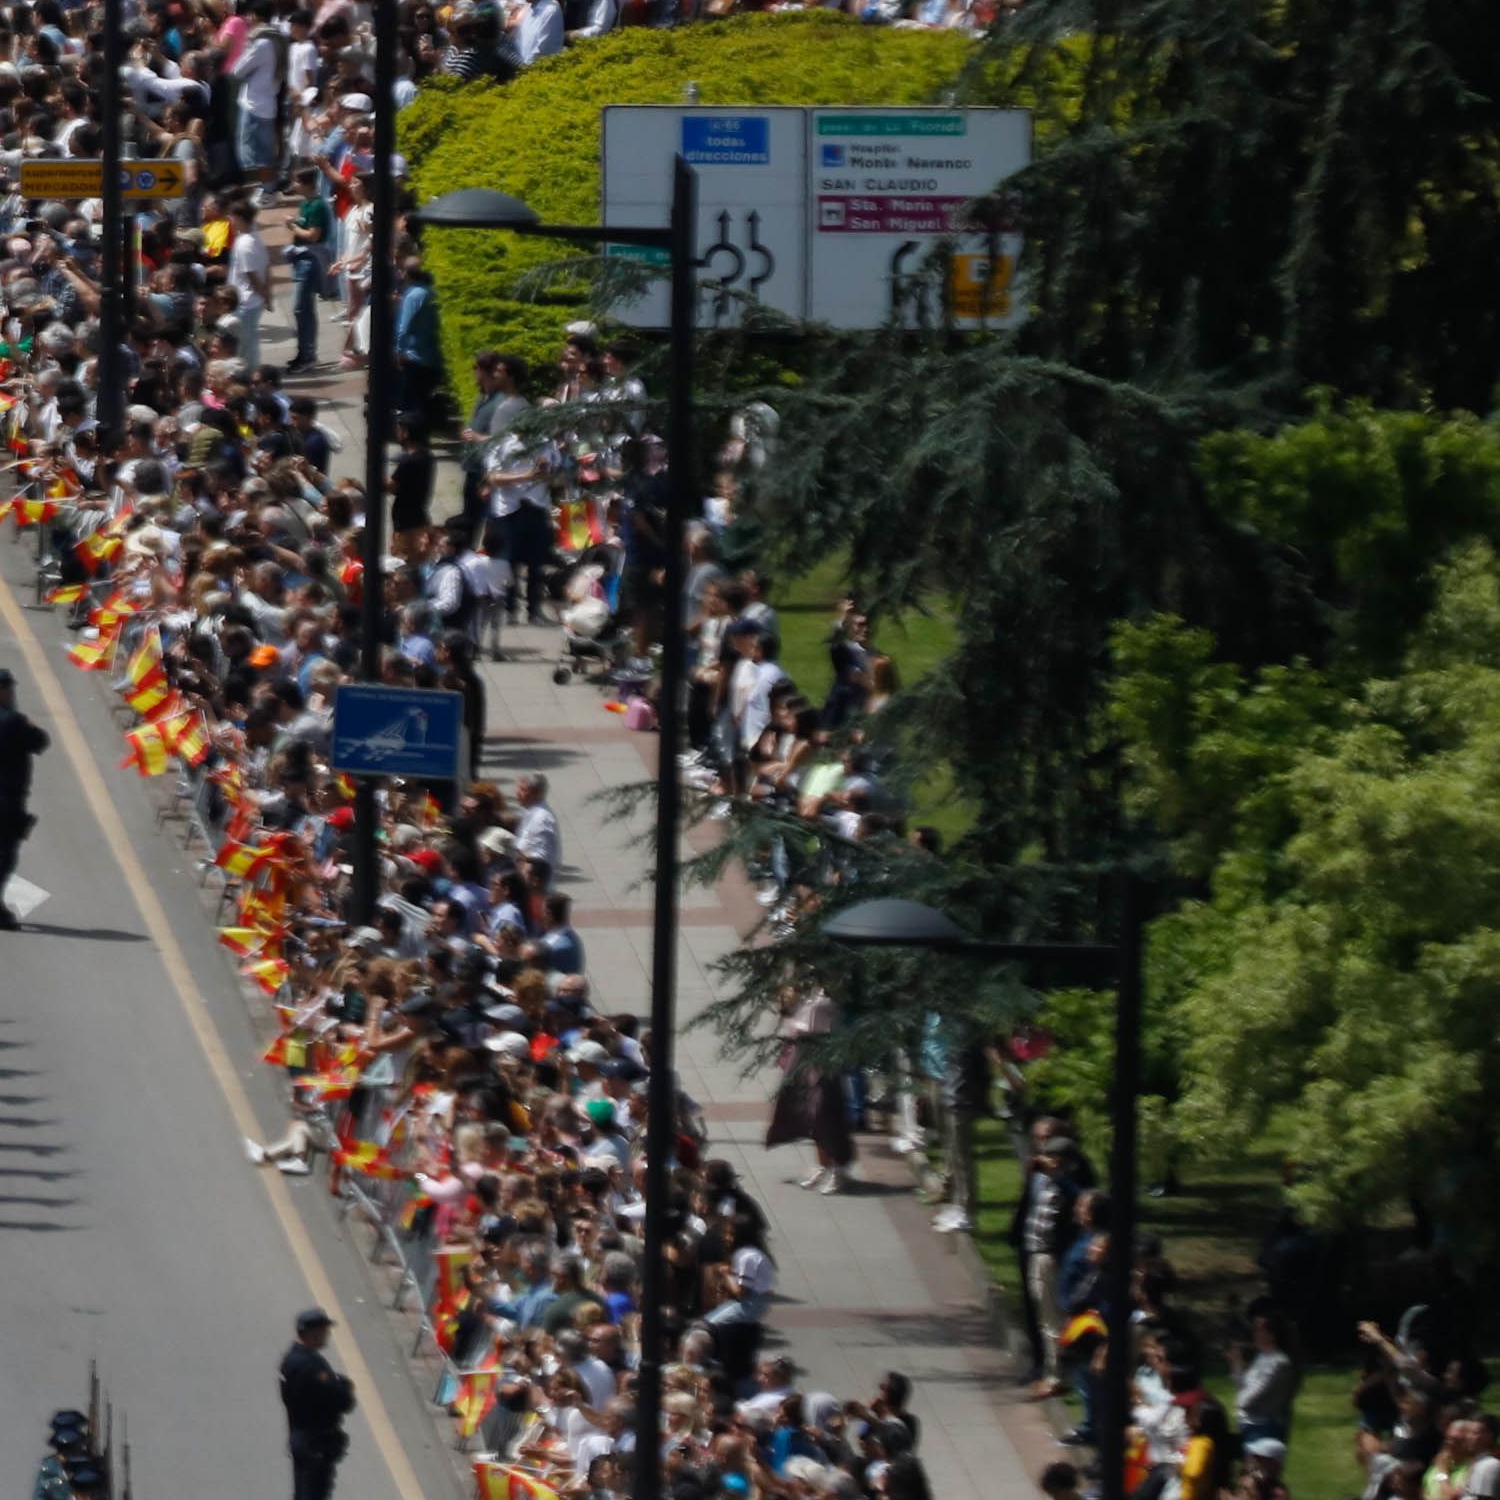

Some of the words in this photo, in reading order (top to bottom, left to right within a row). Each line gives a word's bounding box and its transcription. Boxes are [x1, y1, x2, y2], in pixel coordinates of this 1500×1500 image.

[707, 136, 747, 148] todas
[686, 150, 769, 162] direcciones
[850, 157, 897, 169] Monte
[907, 157, 972, 169] Naranco
[822, 179, 856, 191] SAN
[864, 179, 938, 191] CLAUDIO
[851, 200, 883, 211] Sta.
[852, 218, 880, 229] San
[889, 218, 940, 231] Miguel
